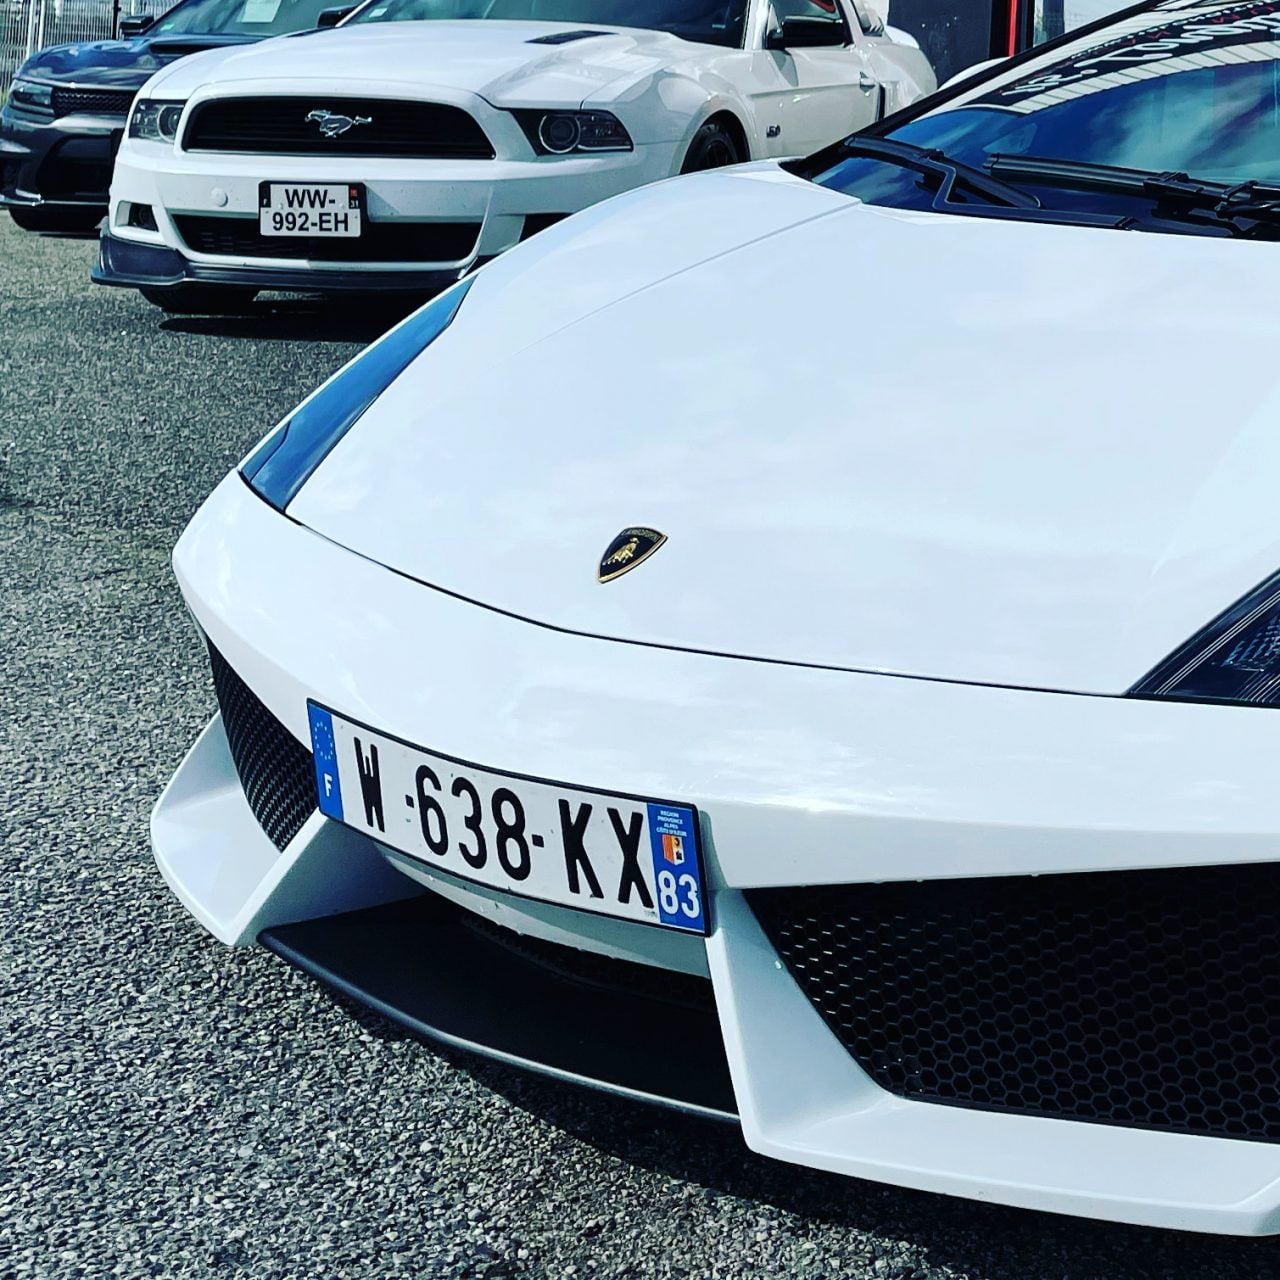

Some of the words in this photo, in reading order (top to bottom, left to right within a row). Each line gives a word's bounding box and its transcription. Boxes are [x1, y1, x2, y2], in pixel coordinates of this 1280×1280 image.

[272, 212, 349, 232] 992-EH
[323, 773, 333, 798] F
[659, 871, 701, 919] 83
